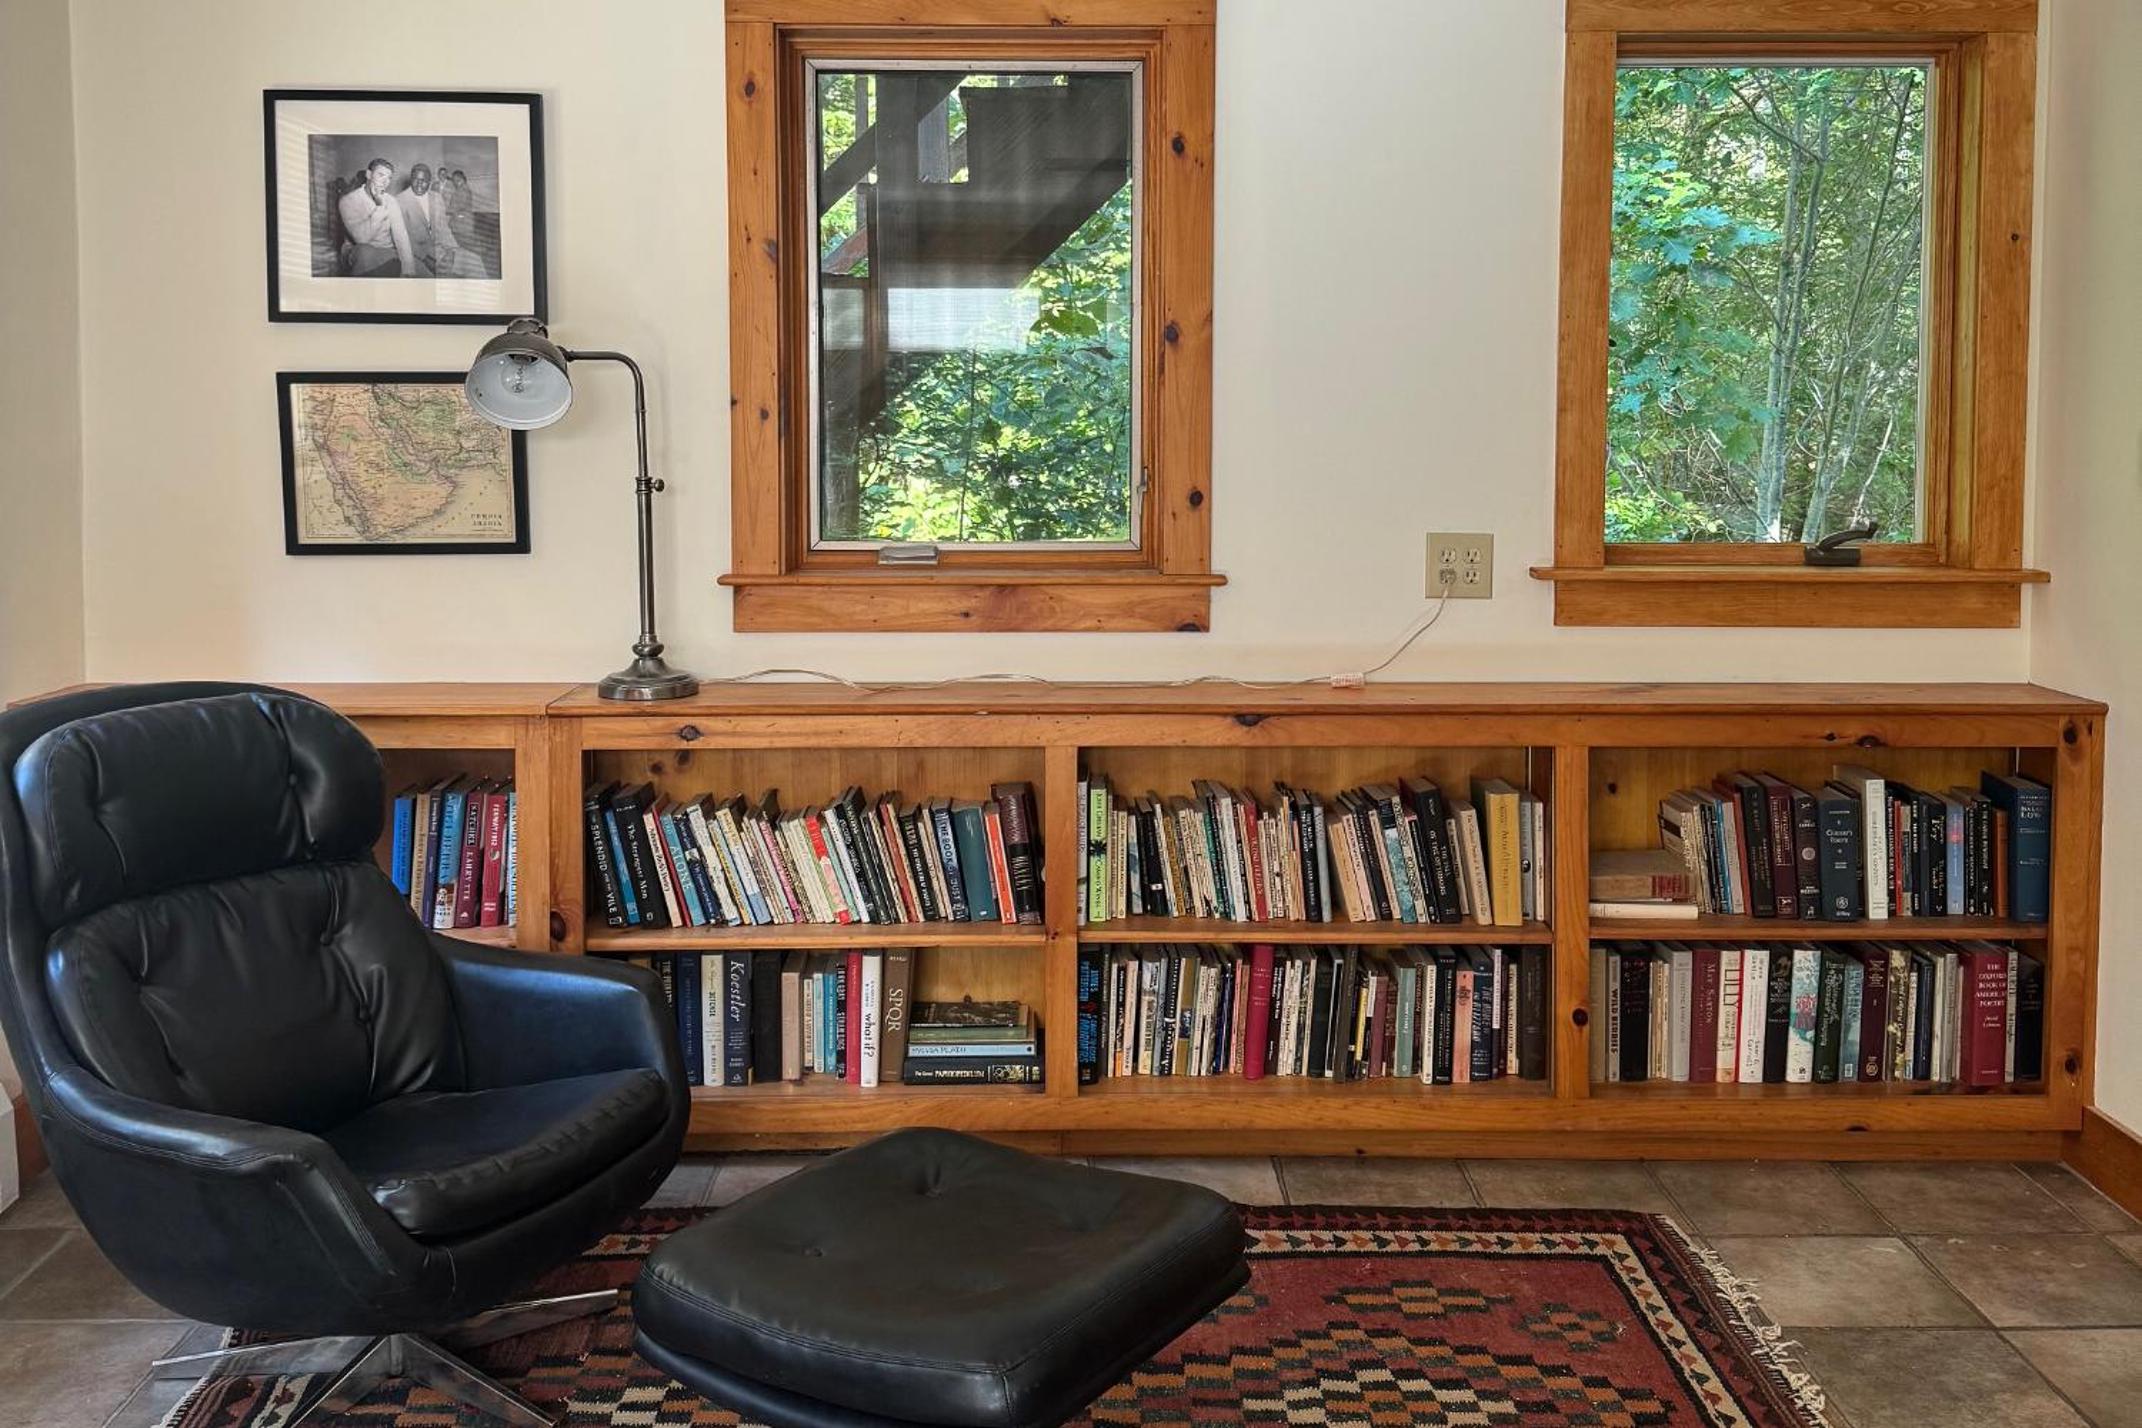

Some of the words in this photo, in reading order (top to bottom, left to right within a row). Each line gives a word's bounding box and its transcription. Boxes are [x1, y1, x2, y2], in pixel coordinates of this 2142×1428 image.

[627, 824, 637, 840] The
[590, 824, 608, 872] SPLENDID
[606, 892, 618, 914] VILE
[669, 846, 692, 890] ALONE
[943, 838, 954, 863] BOOK
[950, 878, 961, 901] DUST
[730, 960, 747, 1022] Koestler
[885, 988, 904, 1032] SPQR
[1724, 969, 1742, 1008] LILLY
[864, 1013, 876, 1040] what
[863, 1043, 876, 1058] if?
